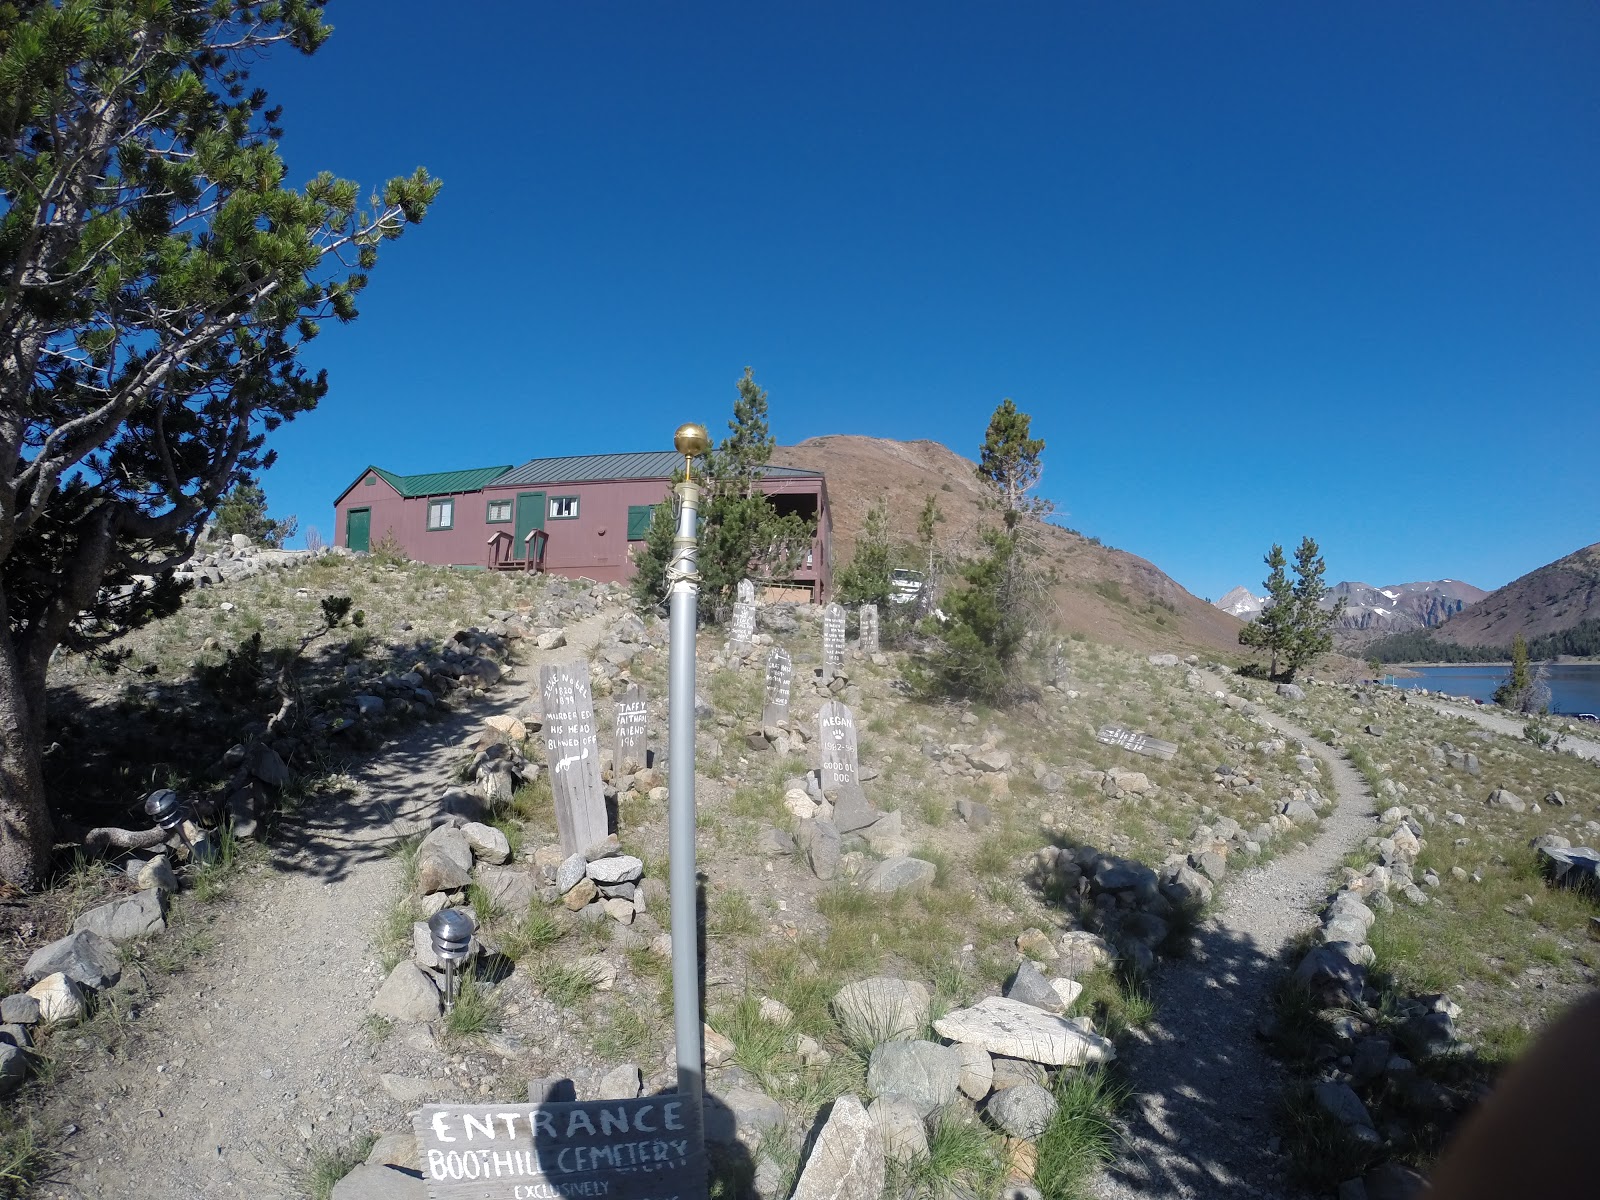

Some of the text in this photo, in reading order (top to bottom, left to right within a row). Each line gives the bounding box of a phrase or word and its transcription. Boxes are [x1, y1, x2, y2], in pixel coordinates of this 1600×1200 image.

[555, 687, 573, 696] 1820
[620, 701, 646, 713] TAFFY
[823, 716, 852, 728] MEGAN
[550, 724, 590, 735] HIS HEAD
[615, 725, 645, 737] FRIEND
[583, 735, 597, 746] OFF
[823, 762, 854, 773] GOOD OL
[833, 772, 850, 783] DOG
[431, 1102, 685, 1143] ENTRANCE
[427, 1139, 688, 1181] BOOTHILL CEMETERY
[514, 1180, 609, 1200] EXCLUSIVELY
